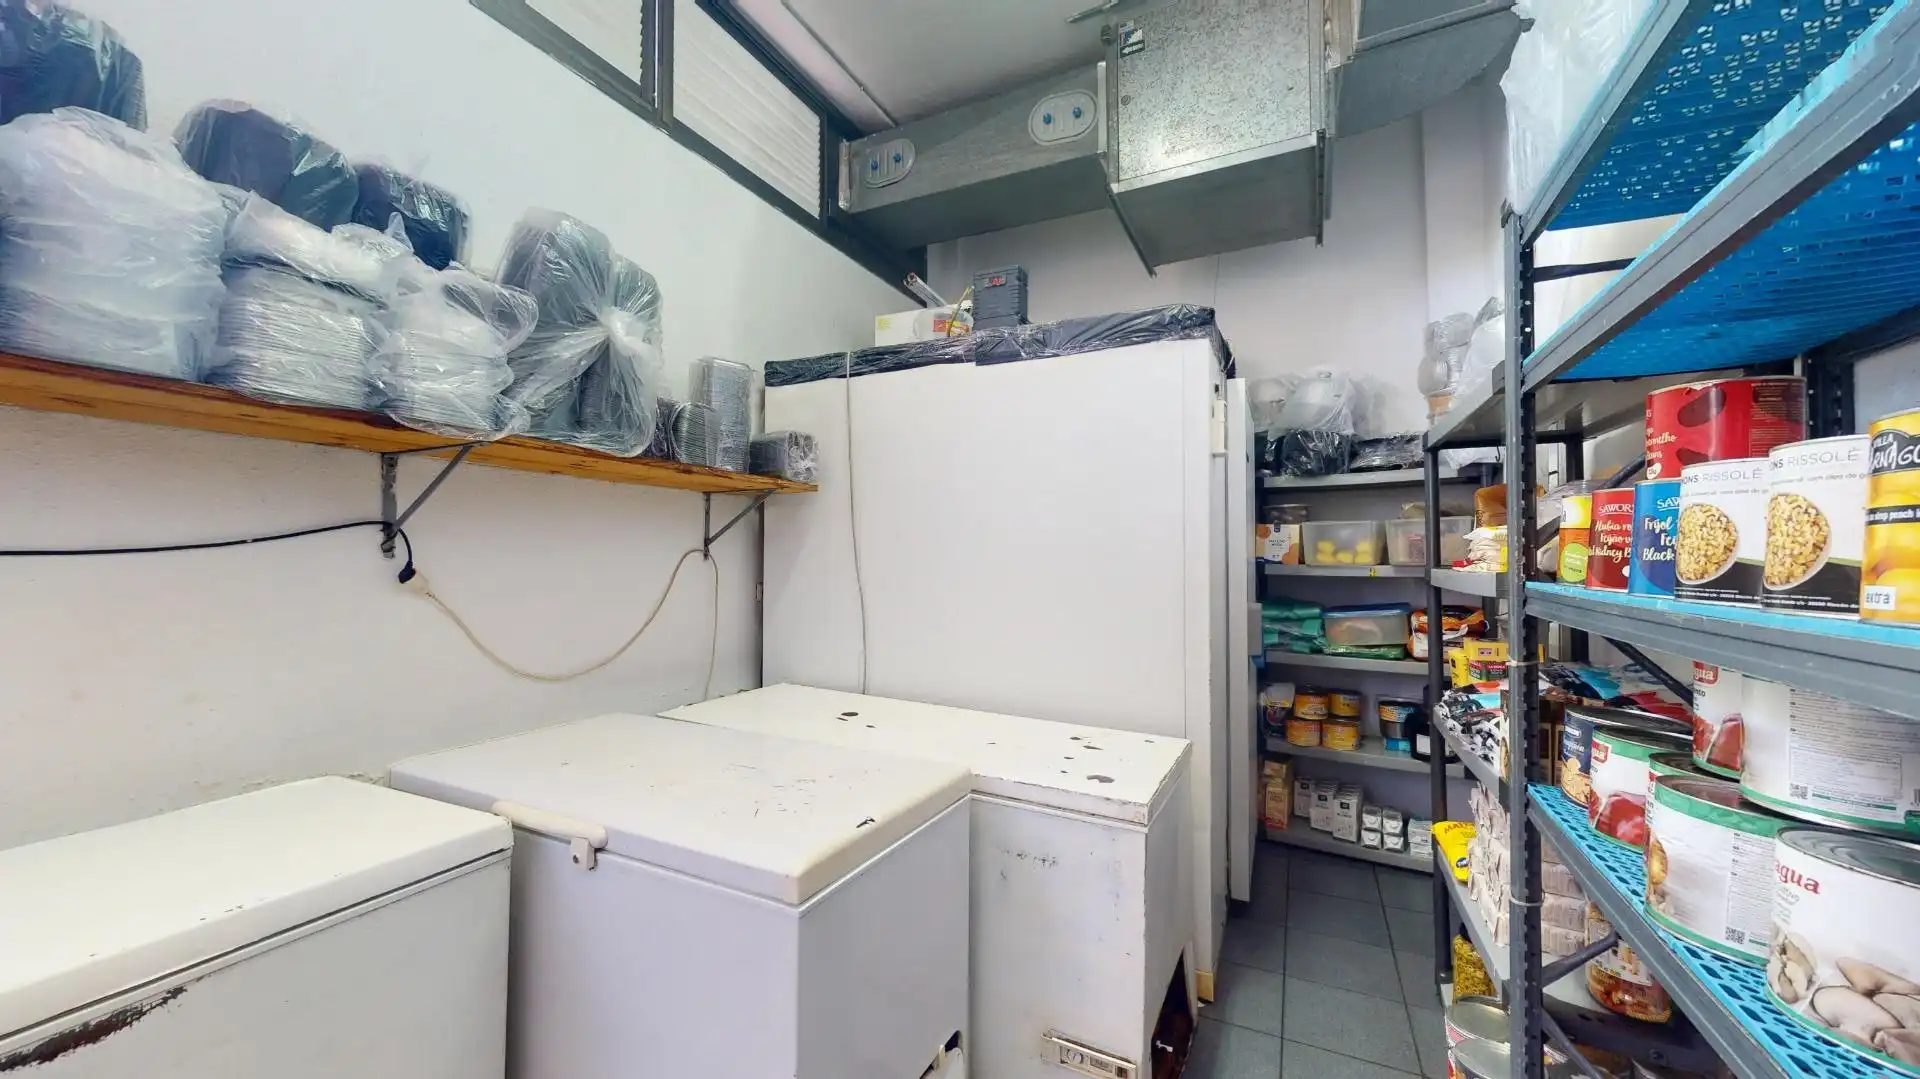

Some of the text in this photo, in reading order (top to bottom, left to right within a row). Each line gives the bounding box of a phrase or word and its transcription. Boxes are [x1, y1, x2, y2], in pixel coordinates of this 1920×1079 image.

[1787, 447, 1862, 467] RISSOLÉ
[1702, 466, 1764, 482] RISSOLÉ
[1643, 547, 1675, 561] Black
